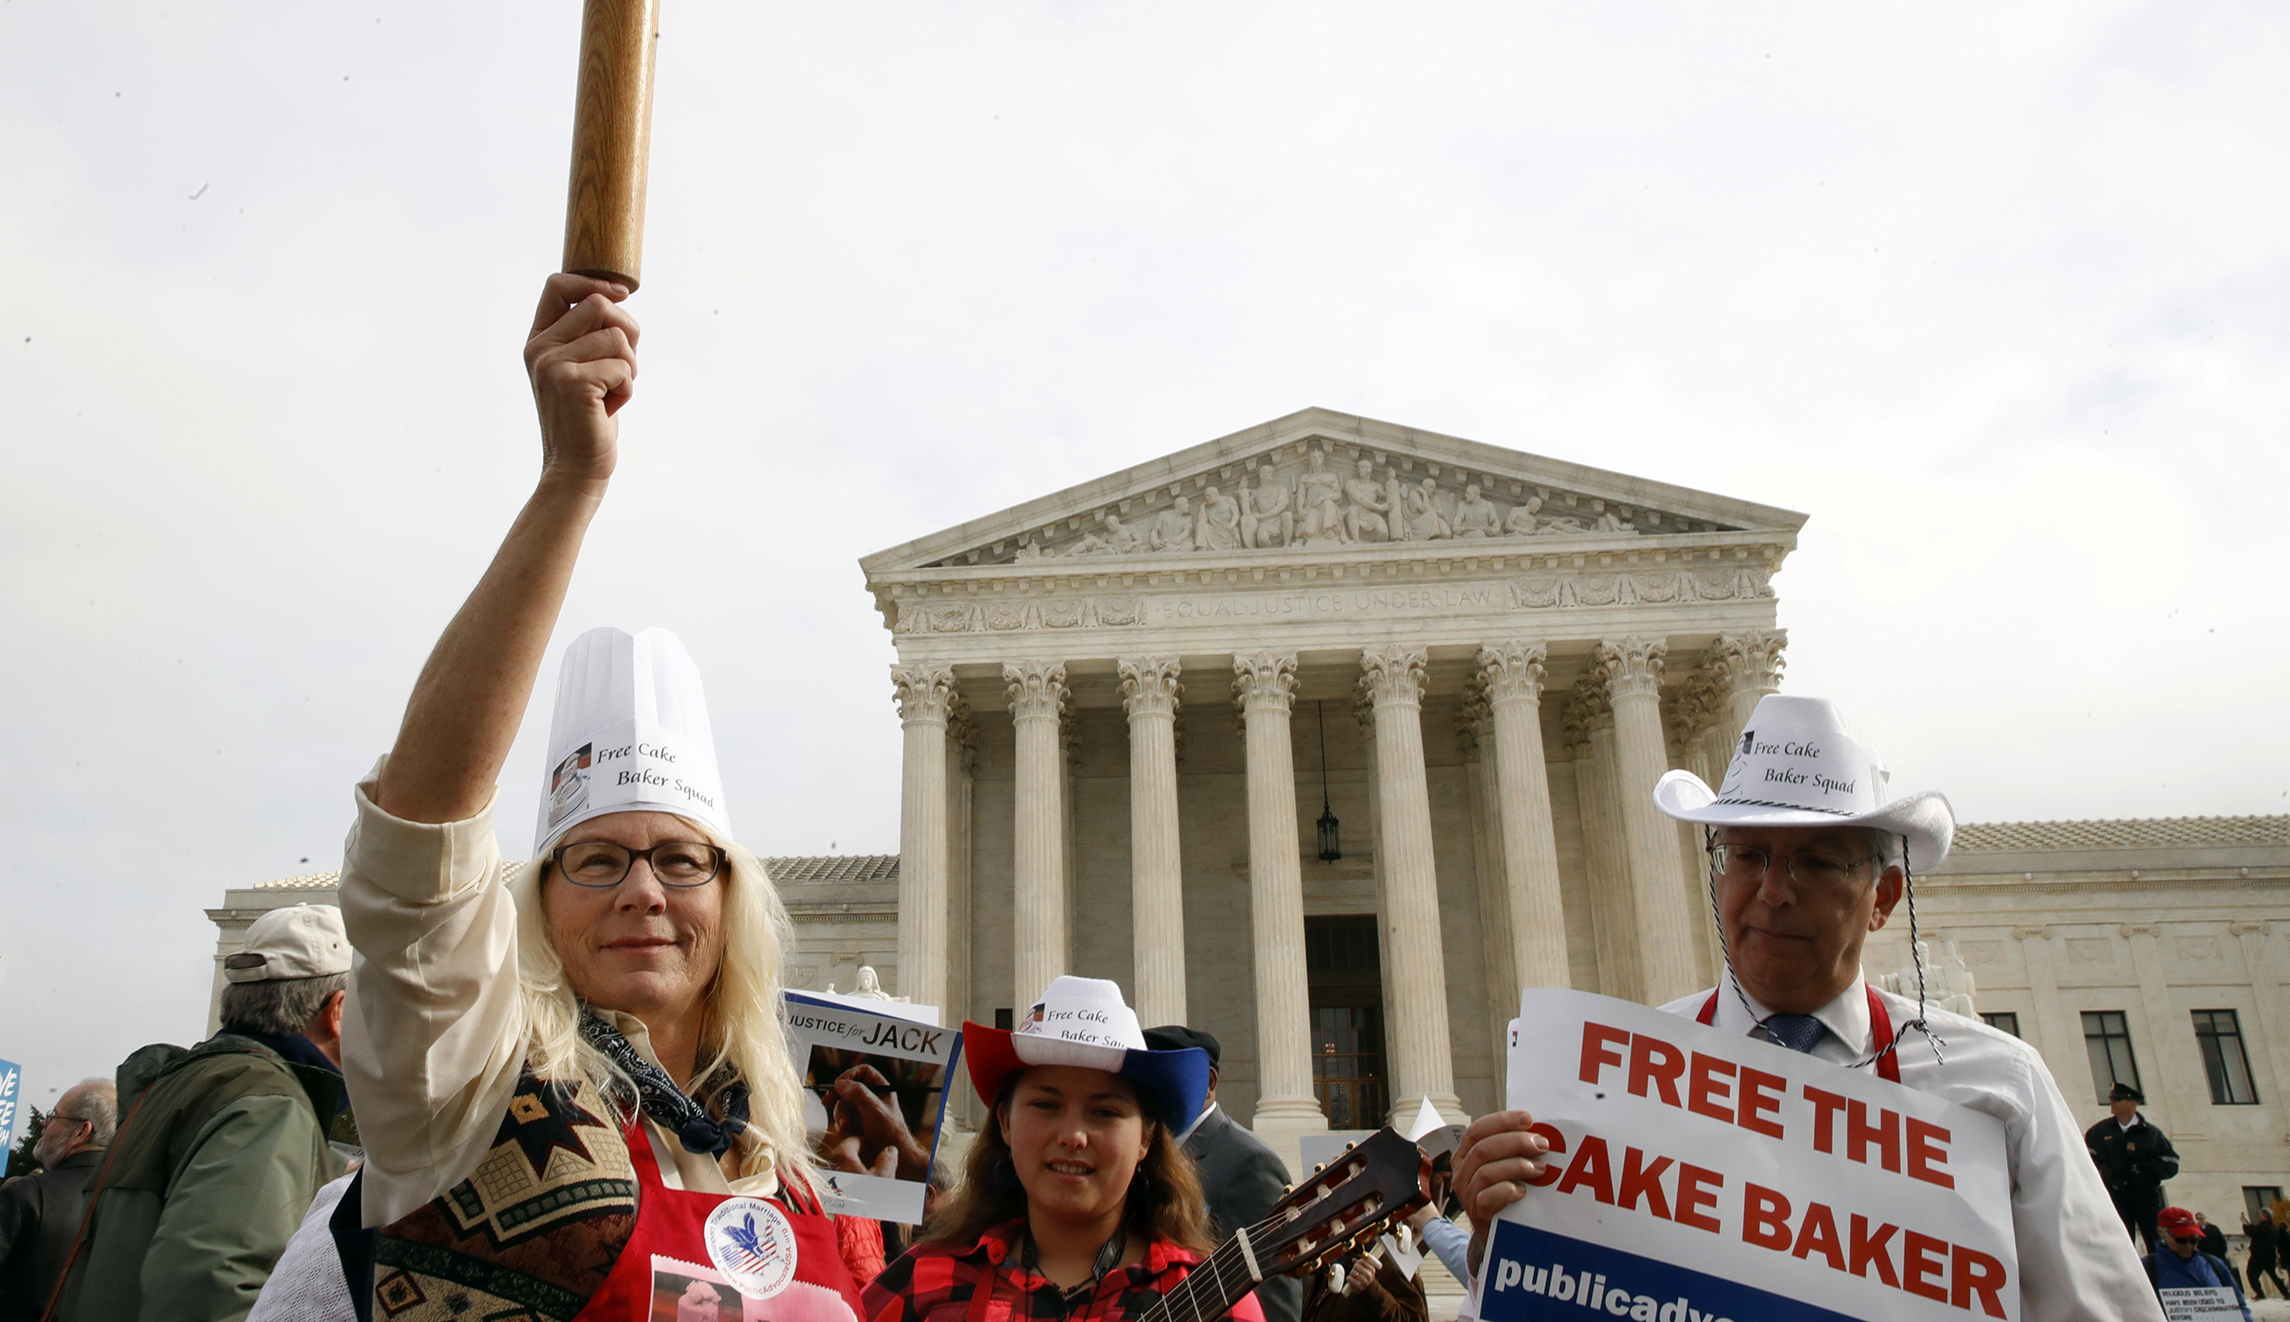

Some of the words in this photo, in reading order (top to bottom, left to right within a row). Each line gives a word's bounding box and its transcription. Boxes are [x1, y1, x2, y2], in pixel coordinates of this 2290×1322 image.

[1163, 600, 1244, 620] EQUAL
[1250, 594, 1343, 616] JUSTICE
[1355, 590, 1438, 611] UNDER
[1445, 588, 1492, 607] LAW
[595, 743, 633, 765] Free
[638, 742, 676, 764] Cake
[1753, 741, 1780, 756] Free
[1784, 741, 1821, 759] Cake
[616, 767, 670, 788] Baker
[674, 778, 715, 810] Squad
[1763, 767, 1809, 785] Baker
[1812, 773, 1857, 795] Squad
[1047, 1009, 1074, 1022] Free
[1077, 1009, 1109, 1024] Cake
[788, 1014, 847, 1034] JUSTICE
[842, 1024, 866, 1039] for
[862, 1022, 943, 1056] JACK
[1060, 1028, 1100, 1044] Baker
[1578, 1020, 1787, 1141] FREE
[1802, 1084, 1955, 1191] THE
[710, 1201, 747, 1226] Traditional
[749, 1202, 782, 1227] Marriage
[1523, 1122, 1725, 1235] CAKE
[1741, 1181, 2008, 1322] BAKER
